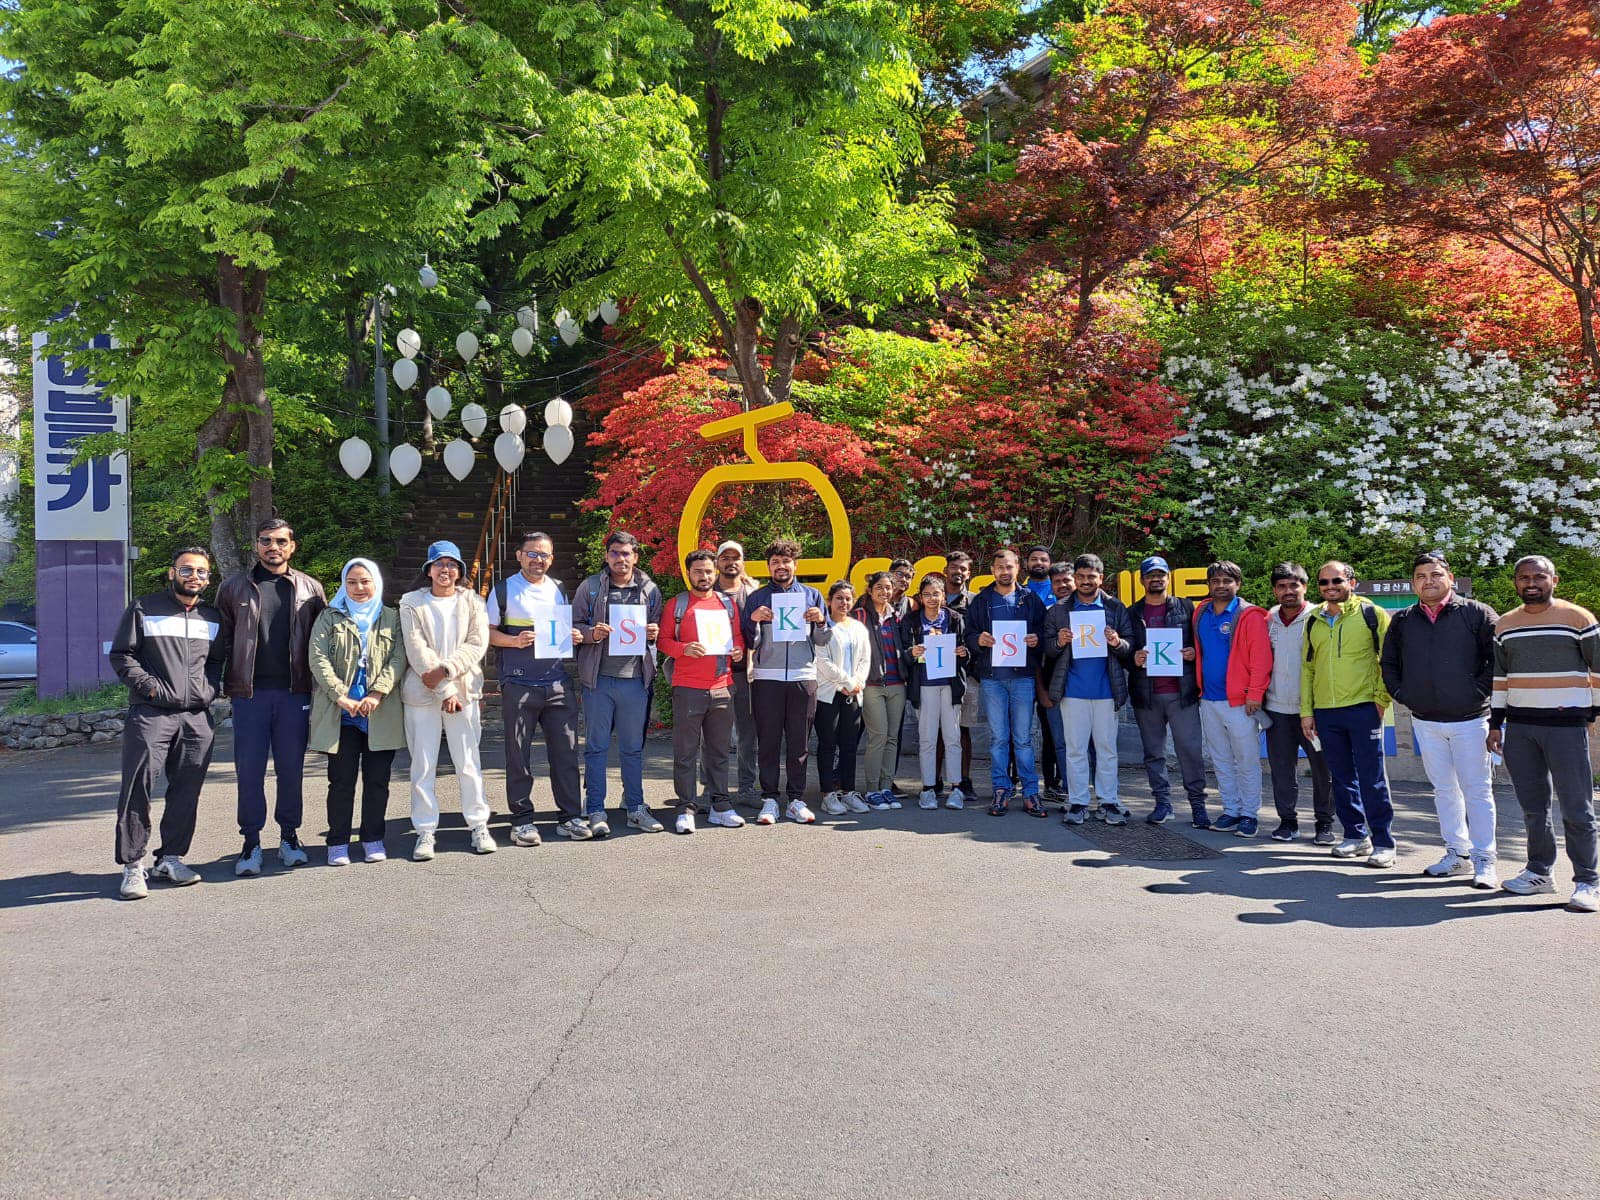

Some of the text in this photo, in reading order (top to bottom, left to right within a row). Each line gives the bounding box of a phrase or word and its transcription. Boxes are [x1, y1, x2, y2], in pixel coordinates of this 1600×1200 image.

[45, 304, 122, 512] 이블카
[778, 607, 800, 630] K
[549, 620, 557, 647] I
[620, 619, 637, 645] S
[1079, 624, 1100, 648] R
[936, 646, 944, 668] I
[1002, 634, 1018, 657] S
[1153, 642, 1176, 666] K
